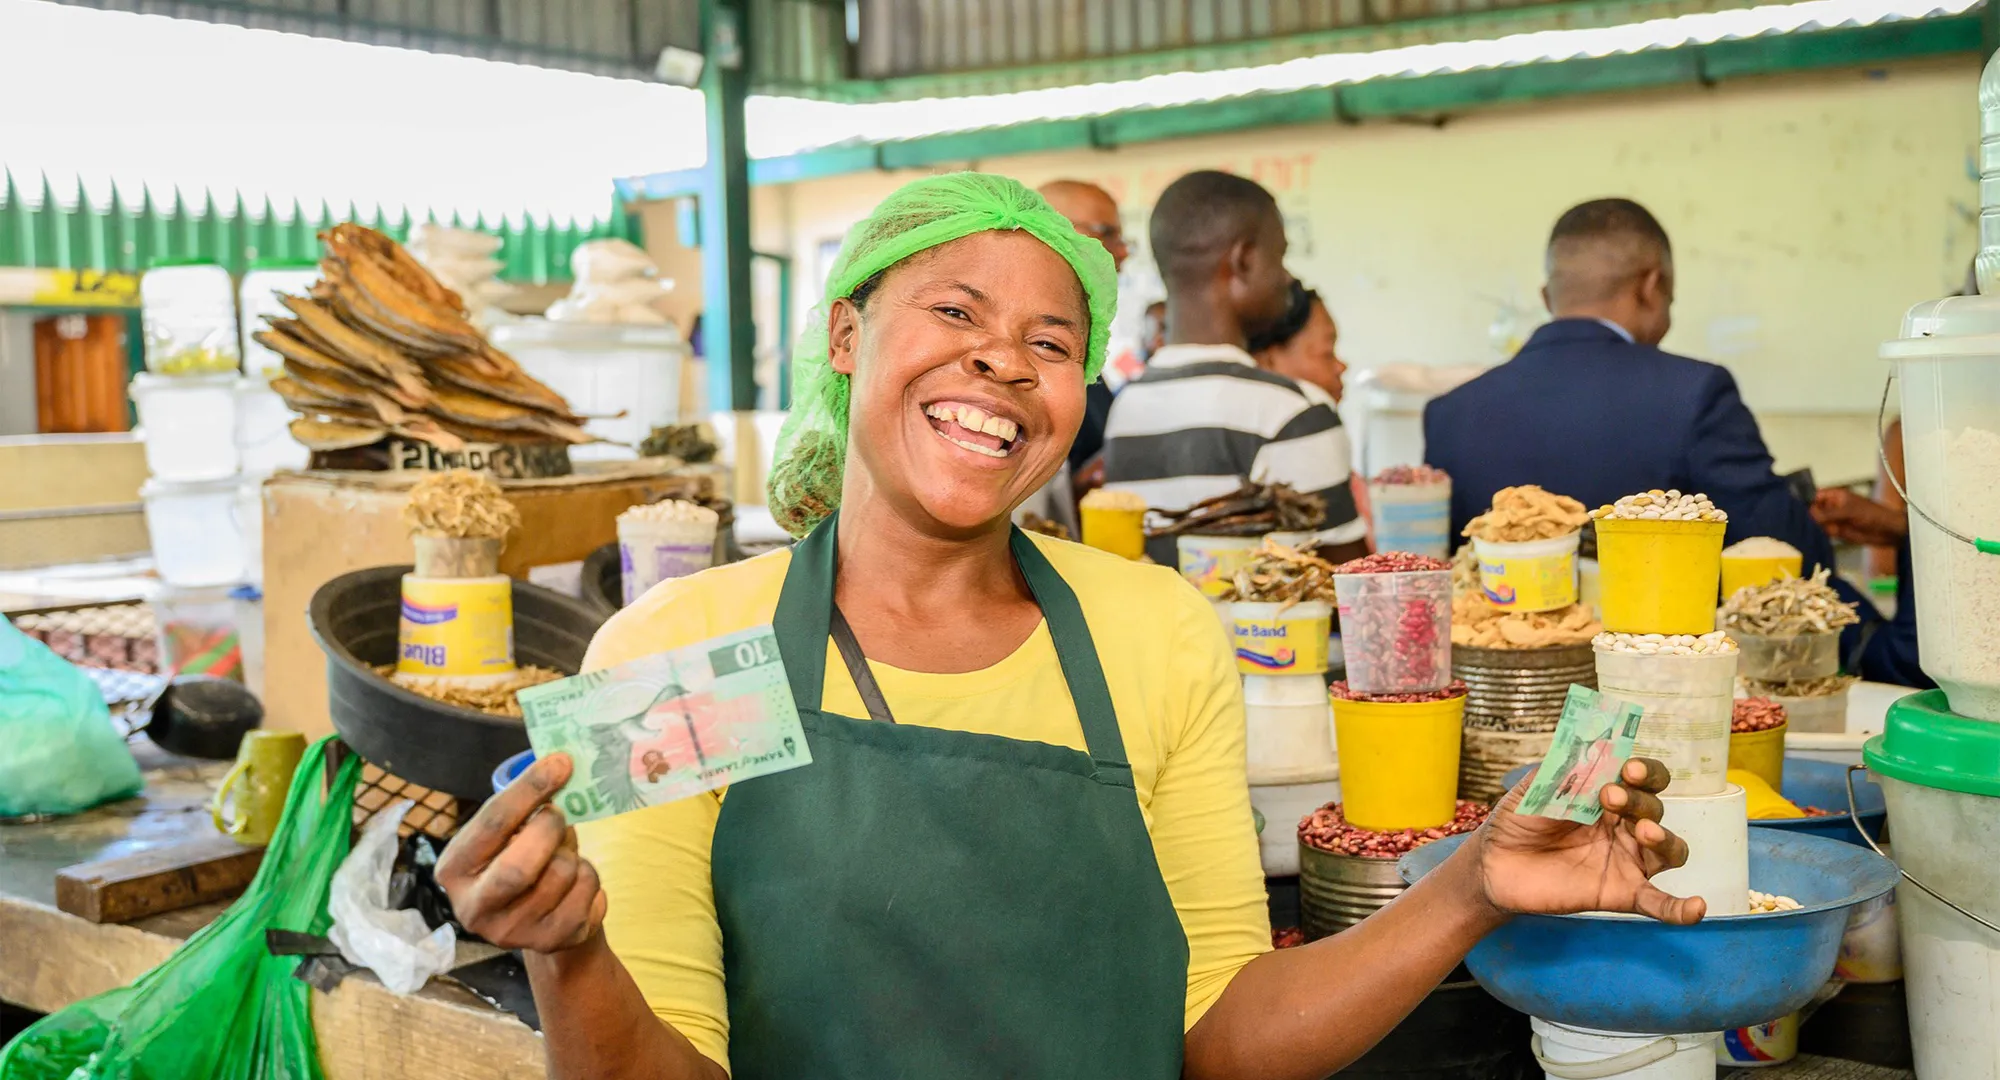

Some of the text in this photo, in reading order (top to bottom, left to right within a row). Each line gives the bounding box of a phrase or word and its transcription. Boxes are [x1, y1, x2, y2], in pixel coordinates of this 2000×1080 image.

[1251, 624, 1286, 637] Band
[404, 644, 446, 667] Blue
[734, 639, 769, 669] 10
[564, 786, 606, 817] 10
